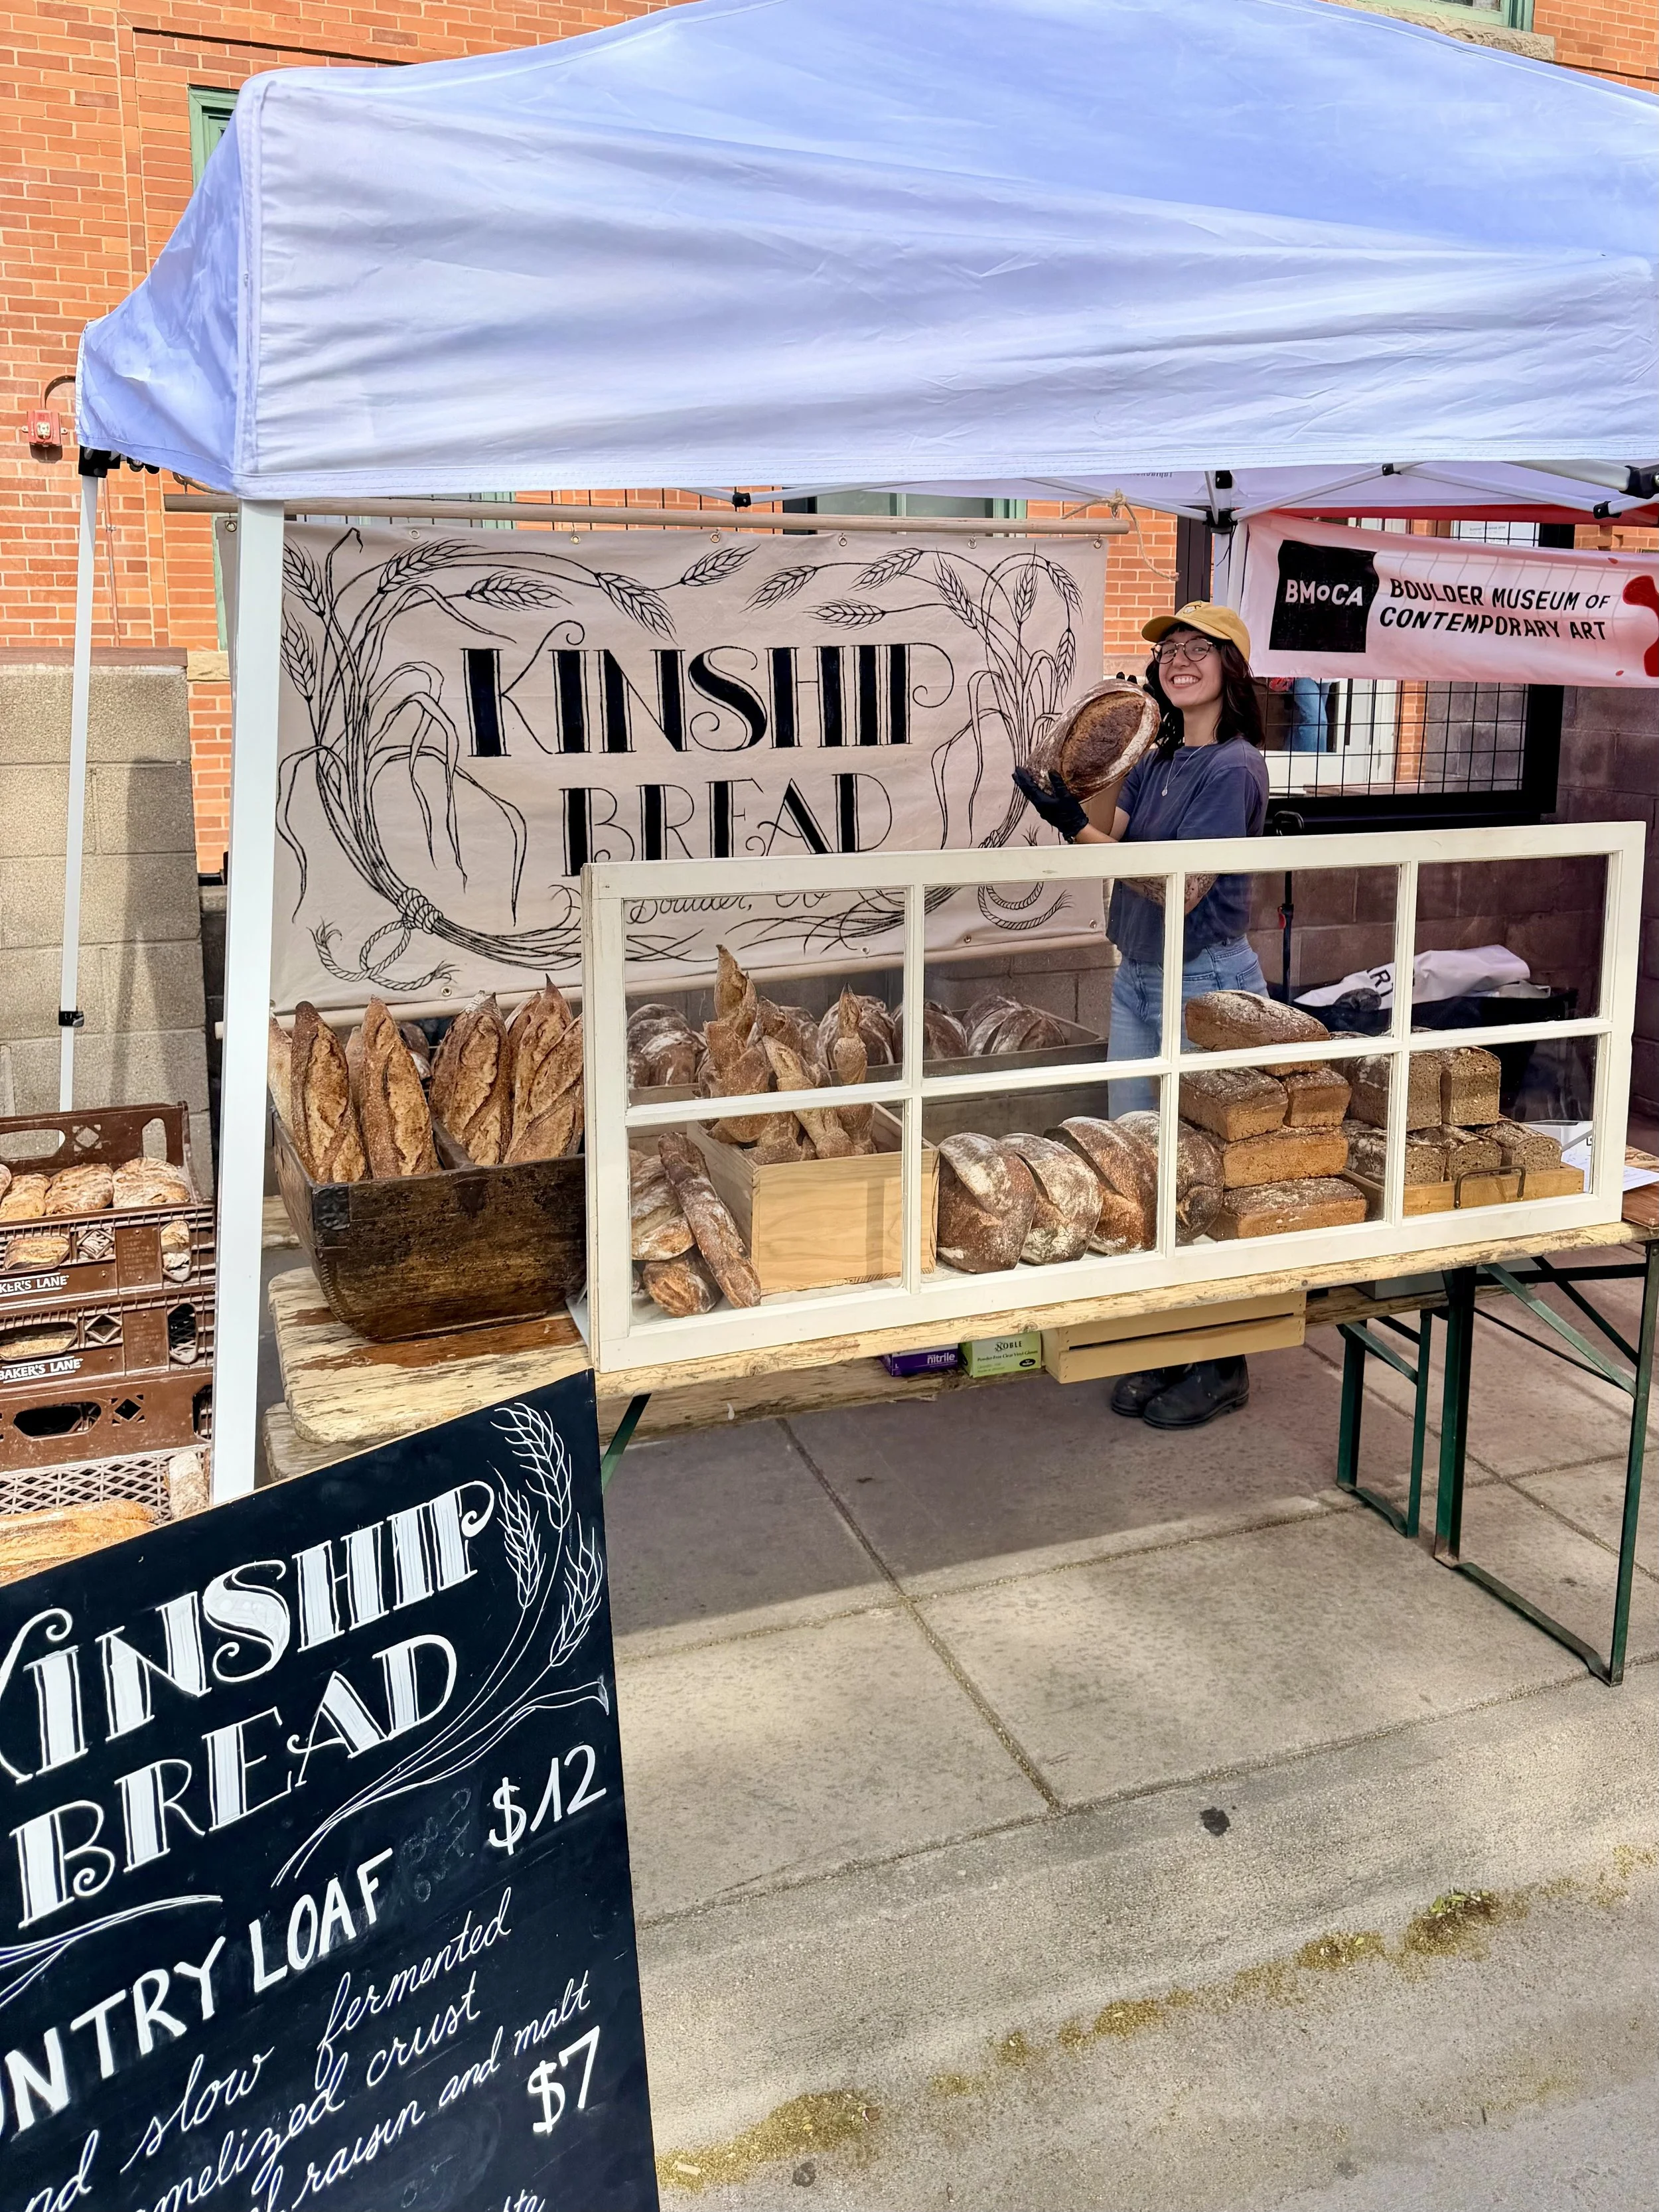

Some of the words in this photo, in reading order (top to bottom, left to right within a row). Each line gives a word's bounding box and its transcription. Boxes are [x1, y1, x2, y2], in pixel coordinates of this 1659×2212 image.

[1380, 607, 1560, 638] CONTEMPORARY
[1569, 621, 1606, 640] ART
[1390, 578, 1483, 607] BOULDER
[1492, 587, 1579, 611] MUSEUM
[1585, 595, 1611, 610] OF
[459, 620, 956, 757] KINSHIP
[559, 773, 893, 877] BREAD
[36, 1276, 68, 1289] LANE
[50, 1359, 81, 1372] LANE
[927, 1353, 956, 1364] nitrile
[995, 1341, 1023, 1352] NOBLE
[9, 1633, 458, 1929] BREAD
[488, 1743, 607, 1856] $12
[0, 1935, 226, 2133] NTRY
[249, 1848, 395, 1992] LOAF
[120, 2045, 275, 2174] slow
[315, 1886, 513, 2089] fermented
[366, 1972, 480, 2087] crust
[292, 2099, 426, 2210] raisin
[439, 2026, 504, 2110] and
[514, 1969, 591, 2056] malt
[528, 2026, 601, 2133] $7
